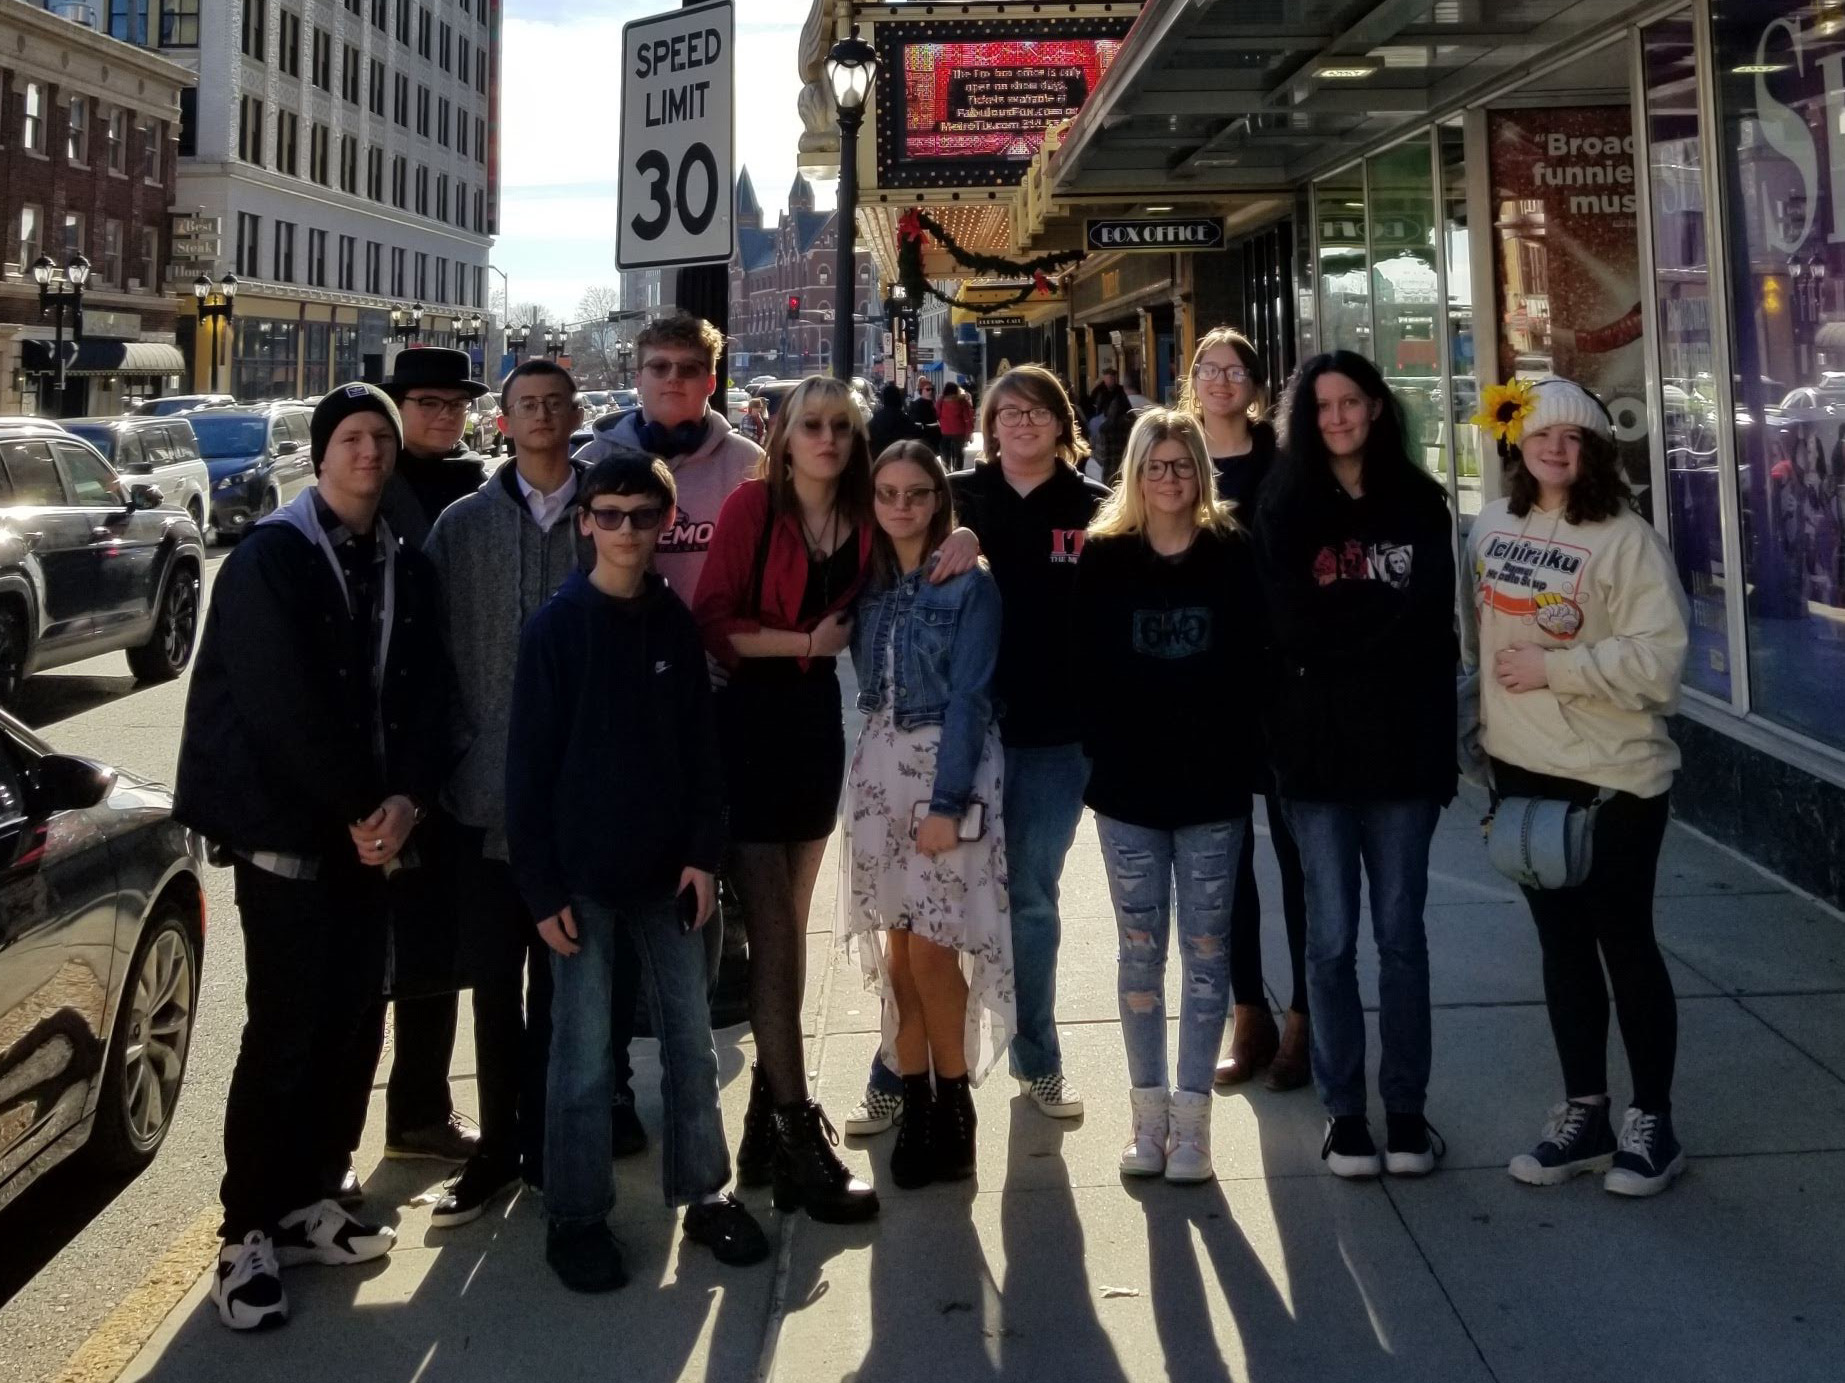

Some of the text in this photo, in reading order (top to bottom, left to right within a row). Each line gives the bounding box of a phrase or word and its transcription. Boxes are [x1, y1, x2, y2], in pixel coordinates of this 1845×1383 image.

[635, 28, 722, 79] SPEED
[1017, 68, 1045, 77] office
[1047, 68, 1056, 77] is
[645, 81, 710, 128] LIMIT
[631, 142, 718, 240] 30
[177, 241, 213, 255] Steak
[1102, 225, 1209, 243] BOX OFFICE
